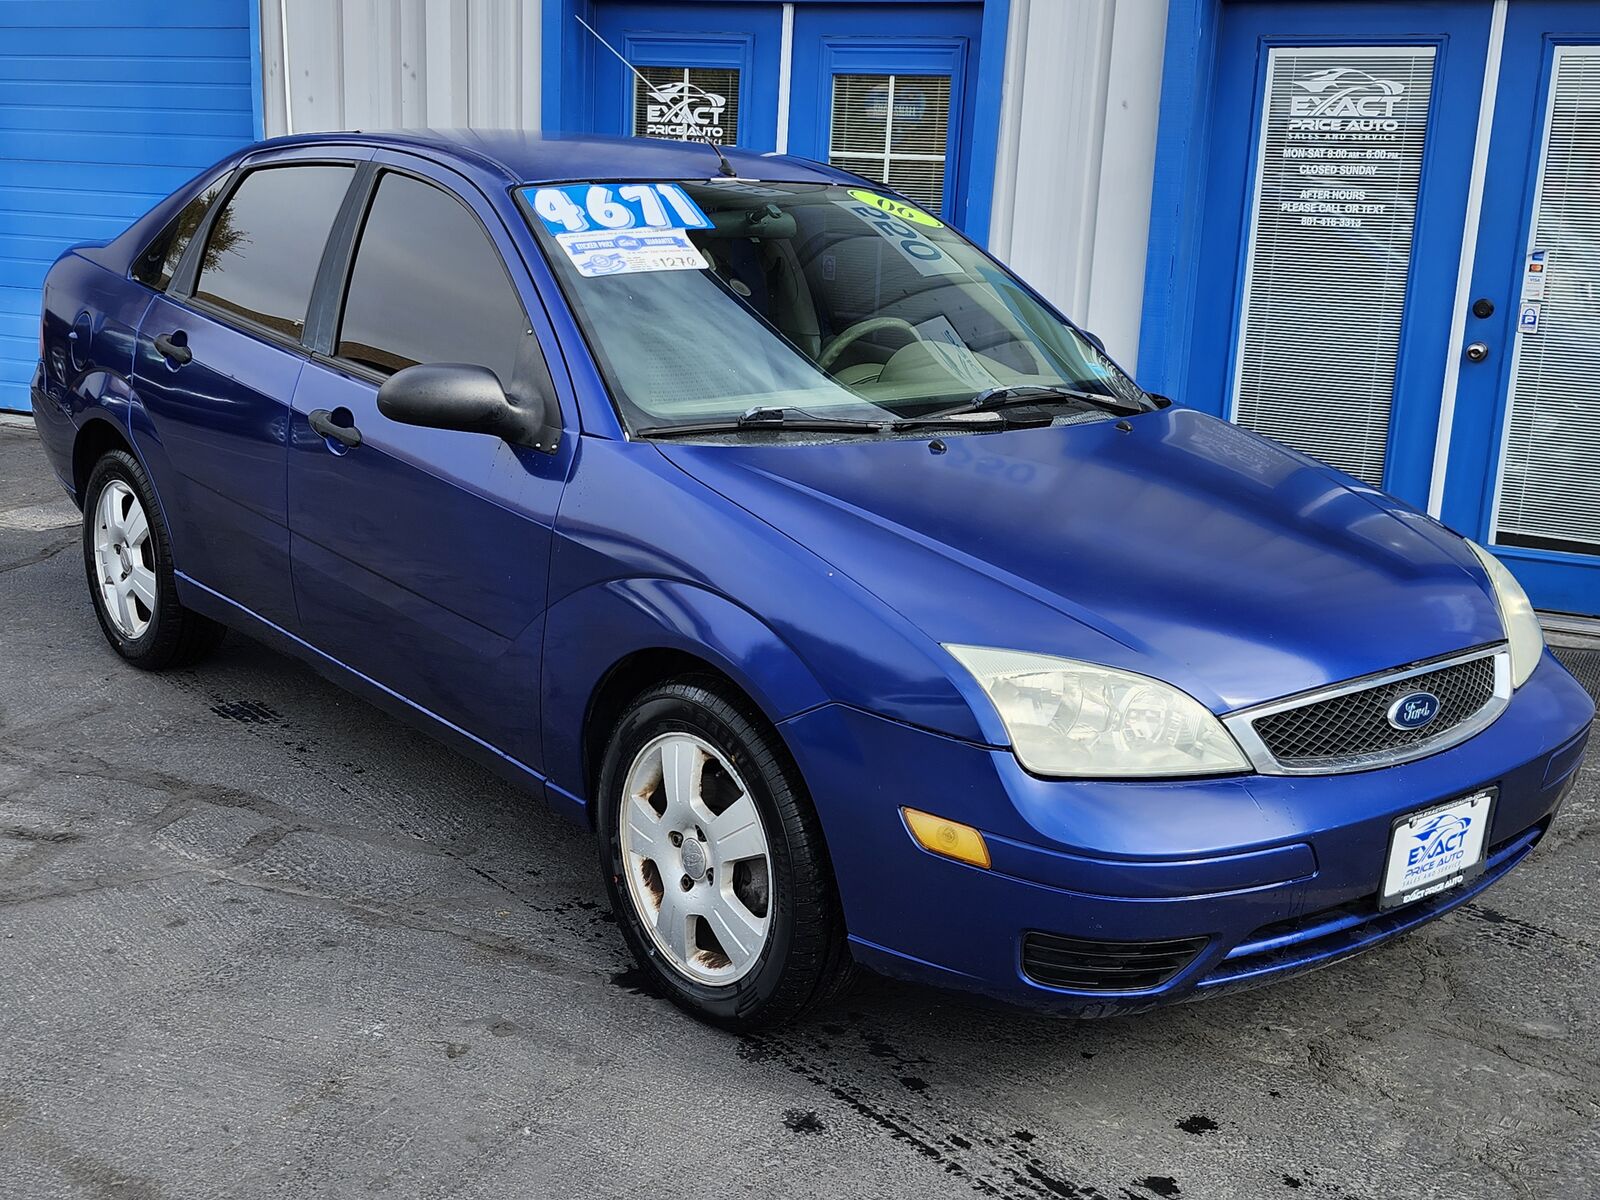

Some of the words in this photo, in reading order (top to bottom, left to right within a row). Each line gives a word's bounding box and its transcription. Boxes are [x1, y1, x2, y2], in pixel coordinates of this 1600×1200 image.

[647, 105, 725, 125] EXACT
[1290, 96, 1402, 117] EXACT
[647, 125, 684, 136] PRICE
[687, 126, 724, 137] AUTO
[1288, 120, 1341, 131] PRICE
[1345, 120, 1399, 132] AUTO
[1299, 165, 1337, 175] CLOSED
[1339, 165, 1378, 176] SUNDAY
[1300, 190, 1330, 200] AFTER
[1333, 190, 1366, 201] HOURS
[534, 184, 708, 231] 4671
[1280, 203, 1316, 213] PLEASE
[1320, 204, 1341, 213] CALL
[1345, 204, 1360, 214] OR
[1362, 205, 1385, 215] TEXT
[1404, 700, 1430, 721] Ford
[1407, 828, 1469, 867] EXACT
[1404, 860, 1435, 879] PRICE
[1437, 850, 1464, 867] AUTO
[1445, 875, 1463, 889] AUTO
